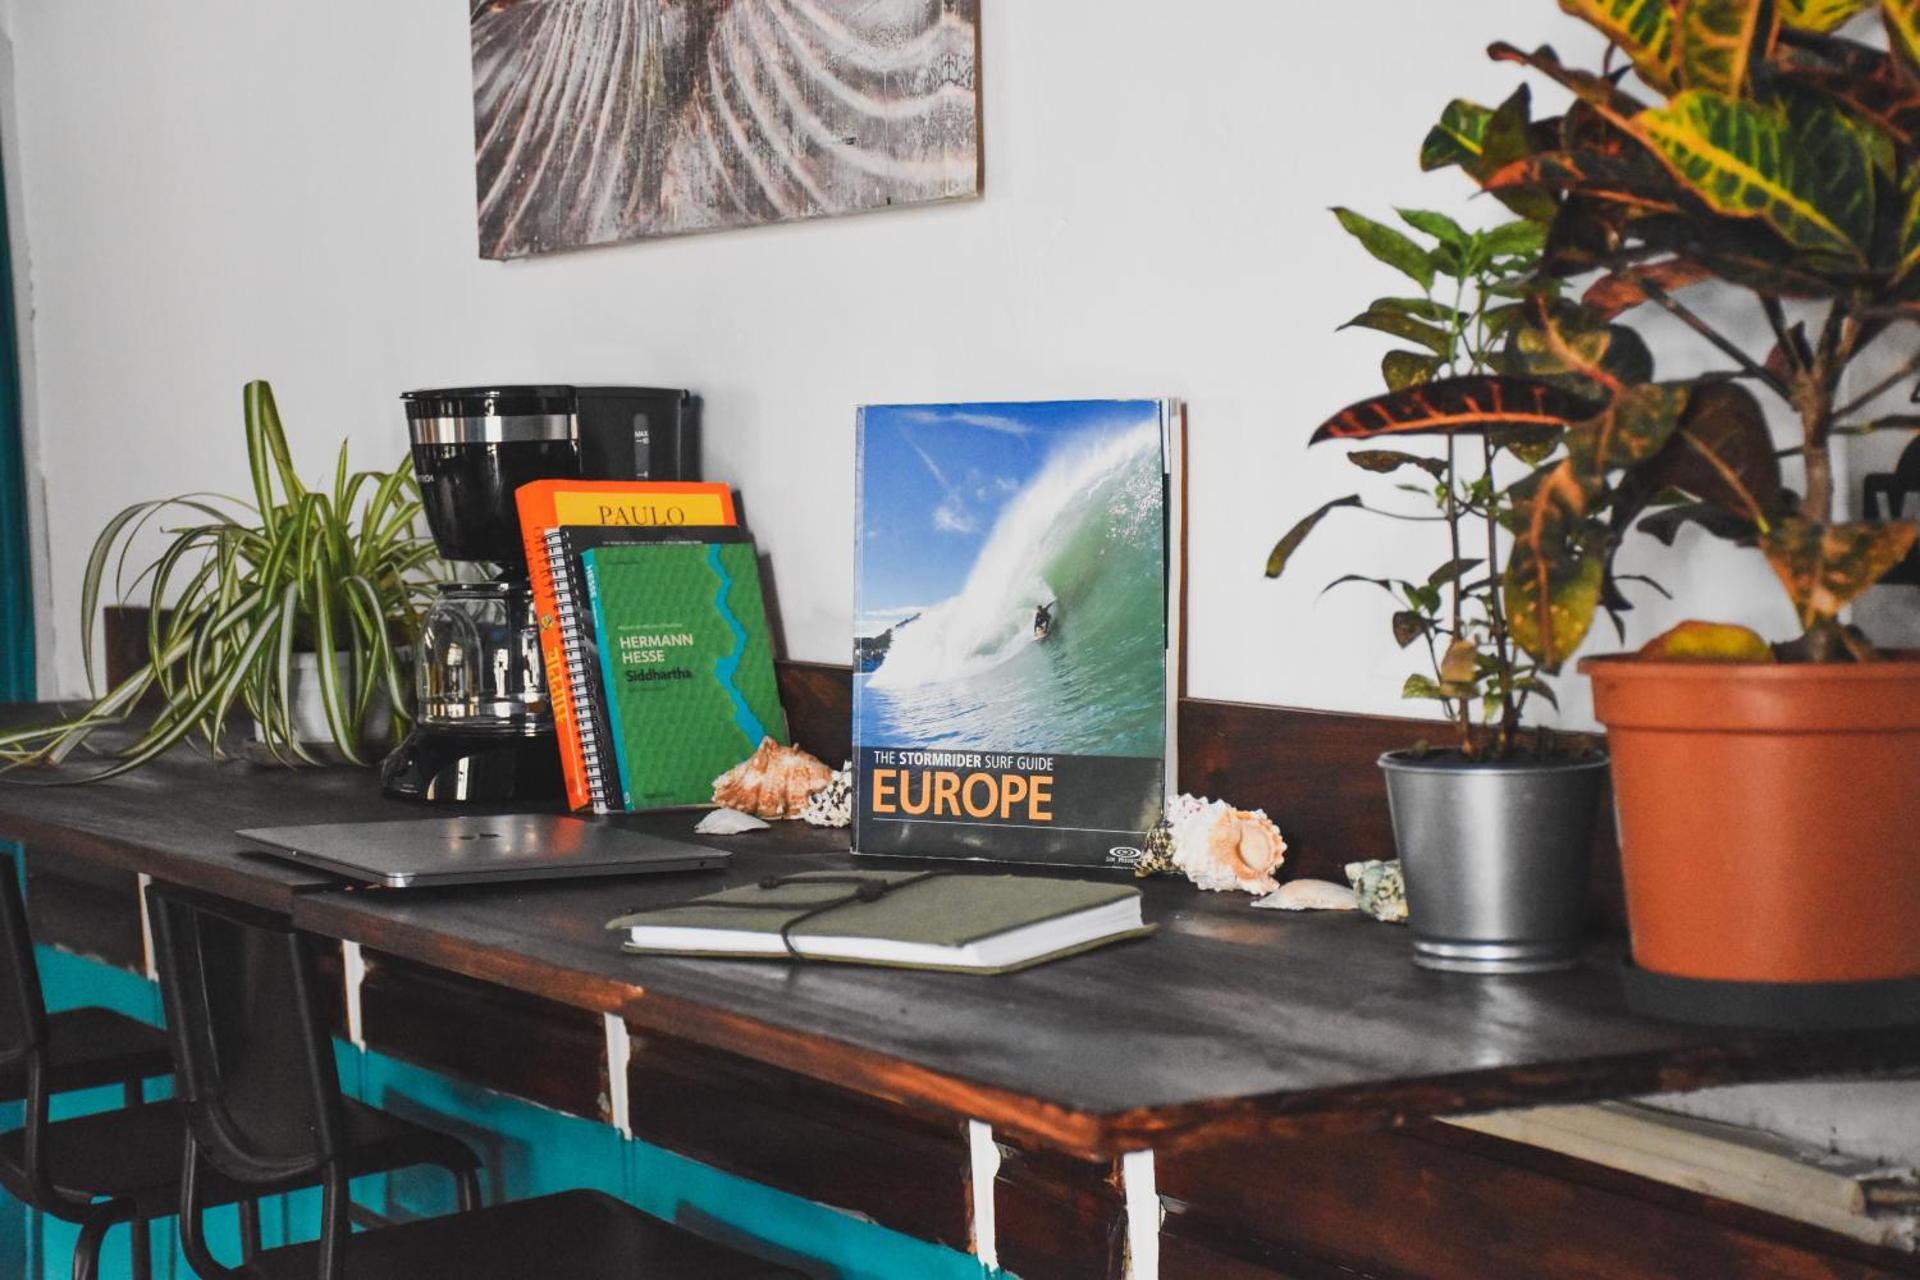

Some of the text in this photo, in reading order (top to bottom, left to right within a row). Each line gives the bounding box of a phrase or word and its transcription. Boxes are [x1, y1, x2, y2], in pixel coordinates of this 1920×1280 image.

[599, 505, 685, 526] PAULO
[619, 633, 694, 649] HERMANN
[622, 650, 665, 664] HESSE
[626, 667, 693, 682] Siddhartha
[873, 751, 1053, 771] THE STORMRIDER SURF GUIDE
[872, 769, 1053, 820] EUROPE
